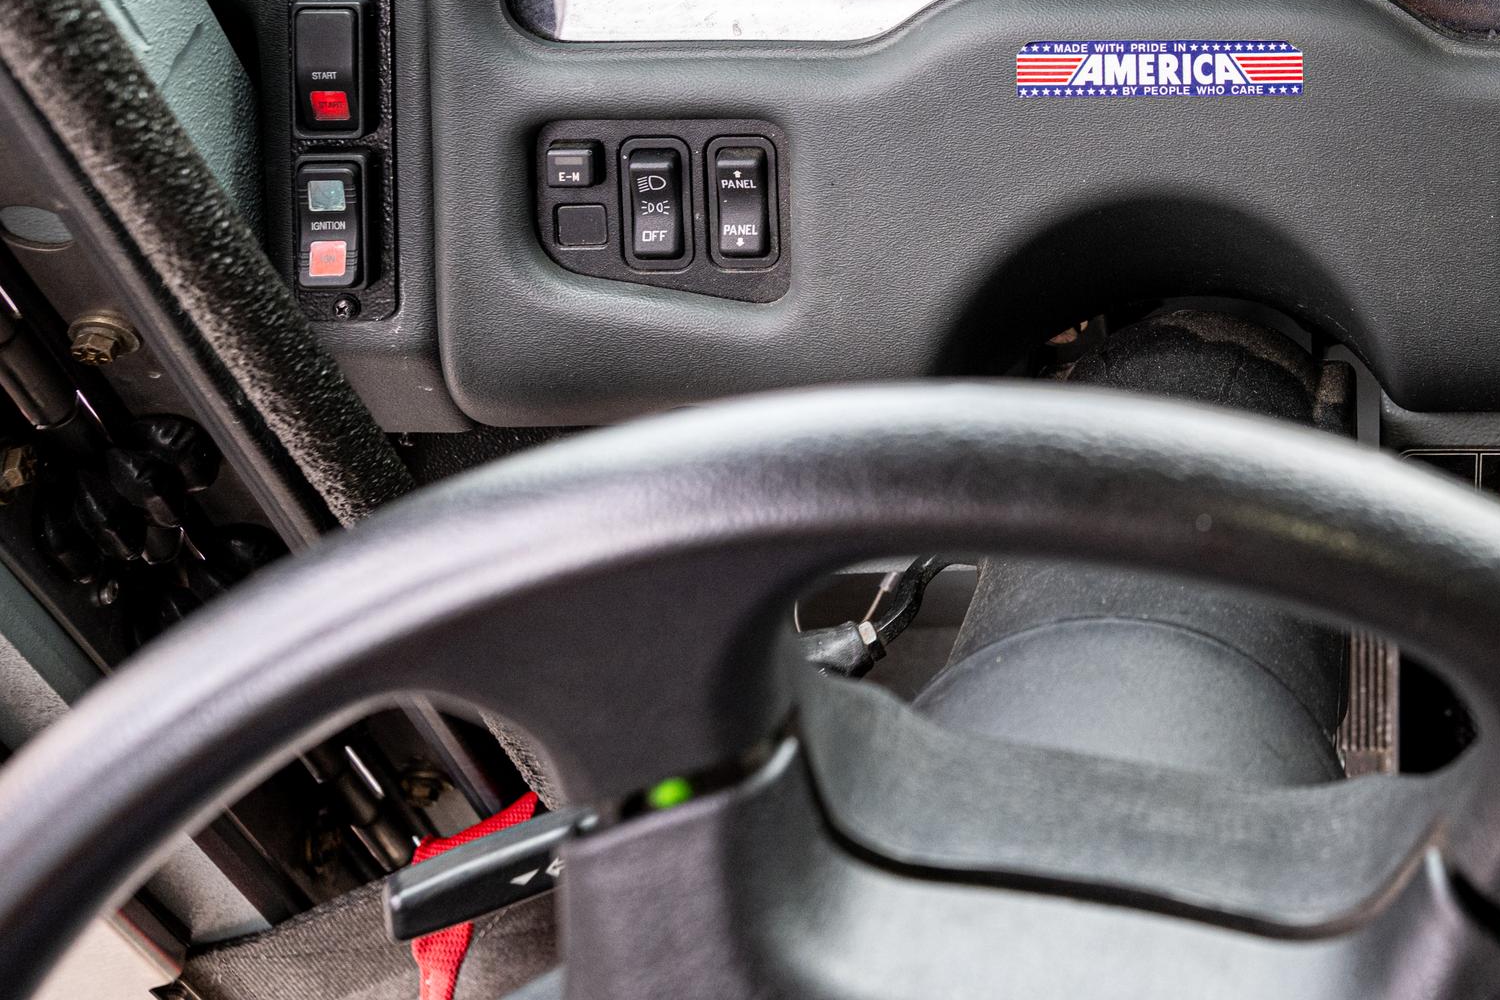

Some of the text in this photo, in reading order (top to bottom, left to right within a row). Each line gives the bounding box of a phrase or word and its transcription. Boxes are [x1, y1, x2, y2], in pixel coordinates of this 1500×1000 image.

[1054, 43, 1186, 53] MADE WITH PRIDE IN
[1071, 53, 1249, 85] AMERICA
[1123, 85, 1263, 95] BY PEOPLE WHO CARE
[559, 172, 580, 182] E-M
[721, 180, 756, 189] PANEL
[311, 222, 345, 230] IGNITION
[723, 225, 758, 235] PANEL
[642, 231, 667, 241] OFF
